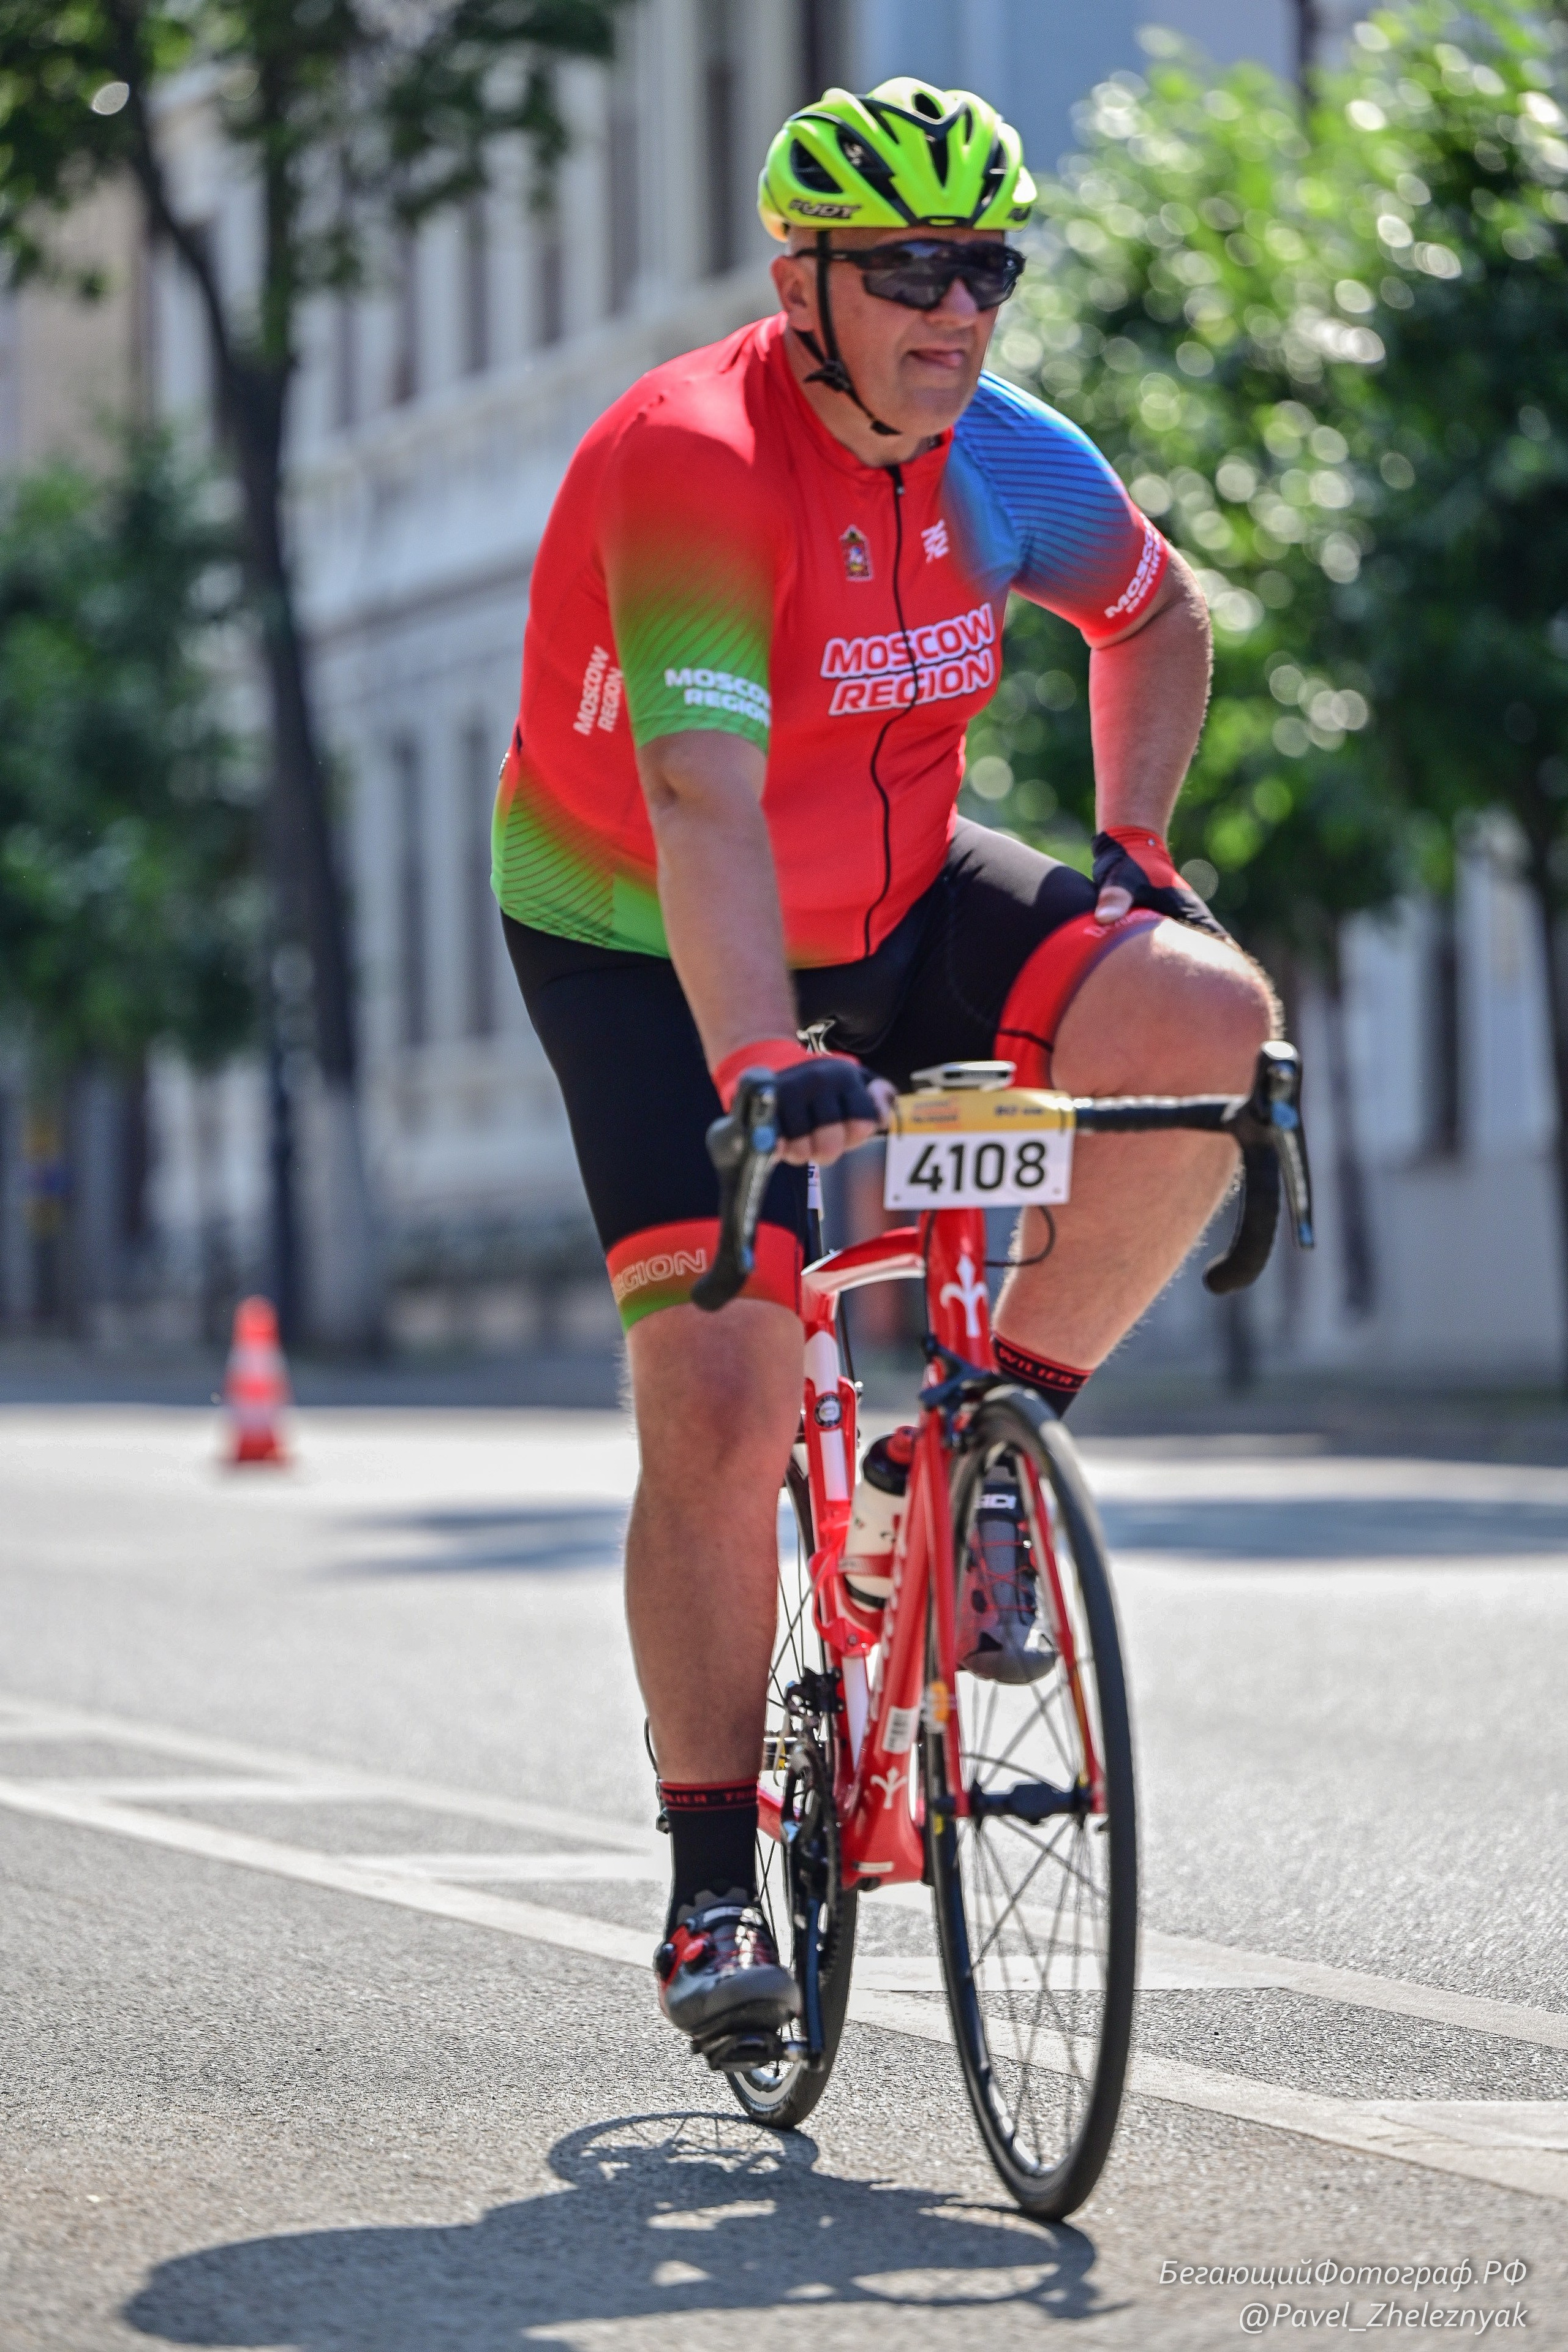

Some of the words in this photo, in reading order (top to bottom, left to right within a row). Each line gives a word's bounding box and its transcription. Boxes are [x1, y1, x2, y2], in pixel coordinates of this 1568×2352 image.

[821, 603, 996, 678] MOSCOW
[573, 645, 610, 736] MOSCOW
[597, 666, 624, 733] REGION
[829, 647, 994, 717] REGION
[908, 1141, 1046, 1193] 4108
[614, 1247, 707, 1301] GION
